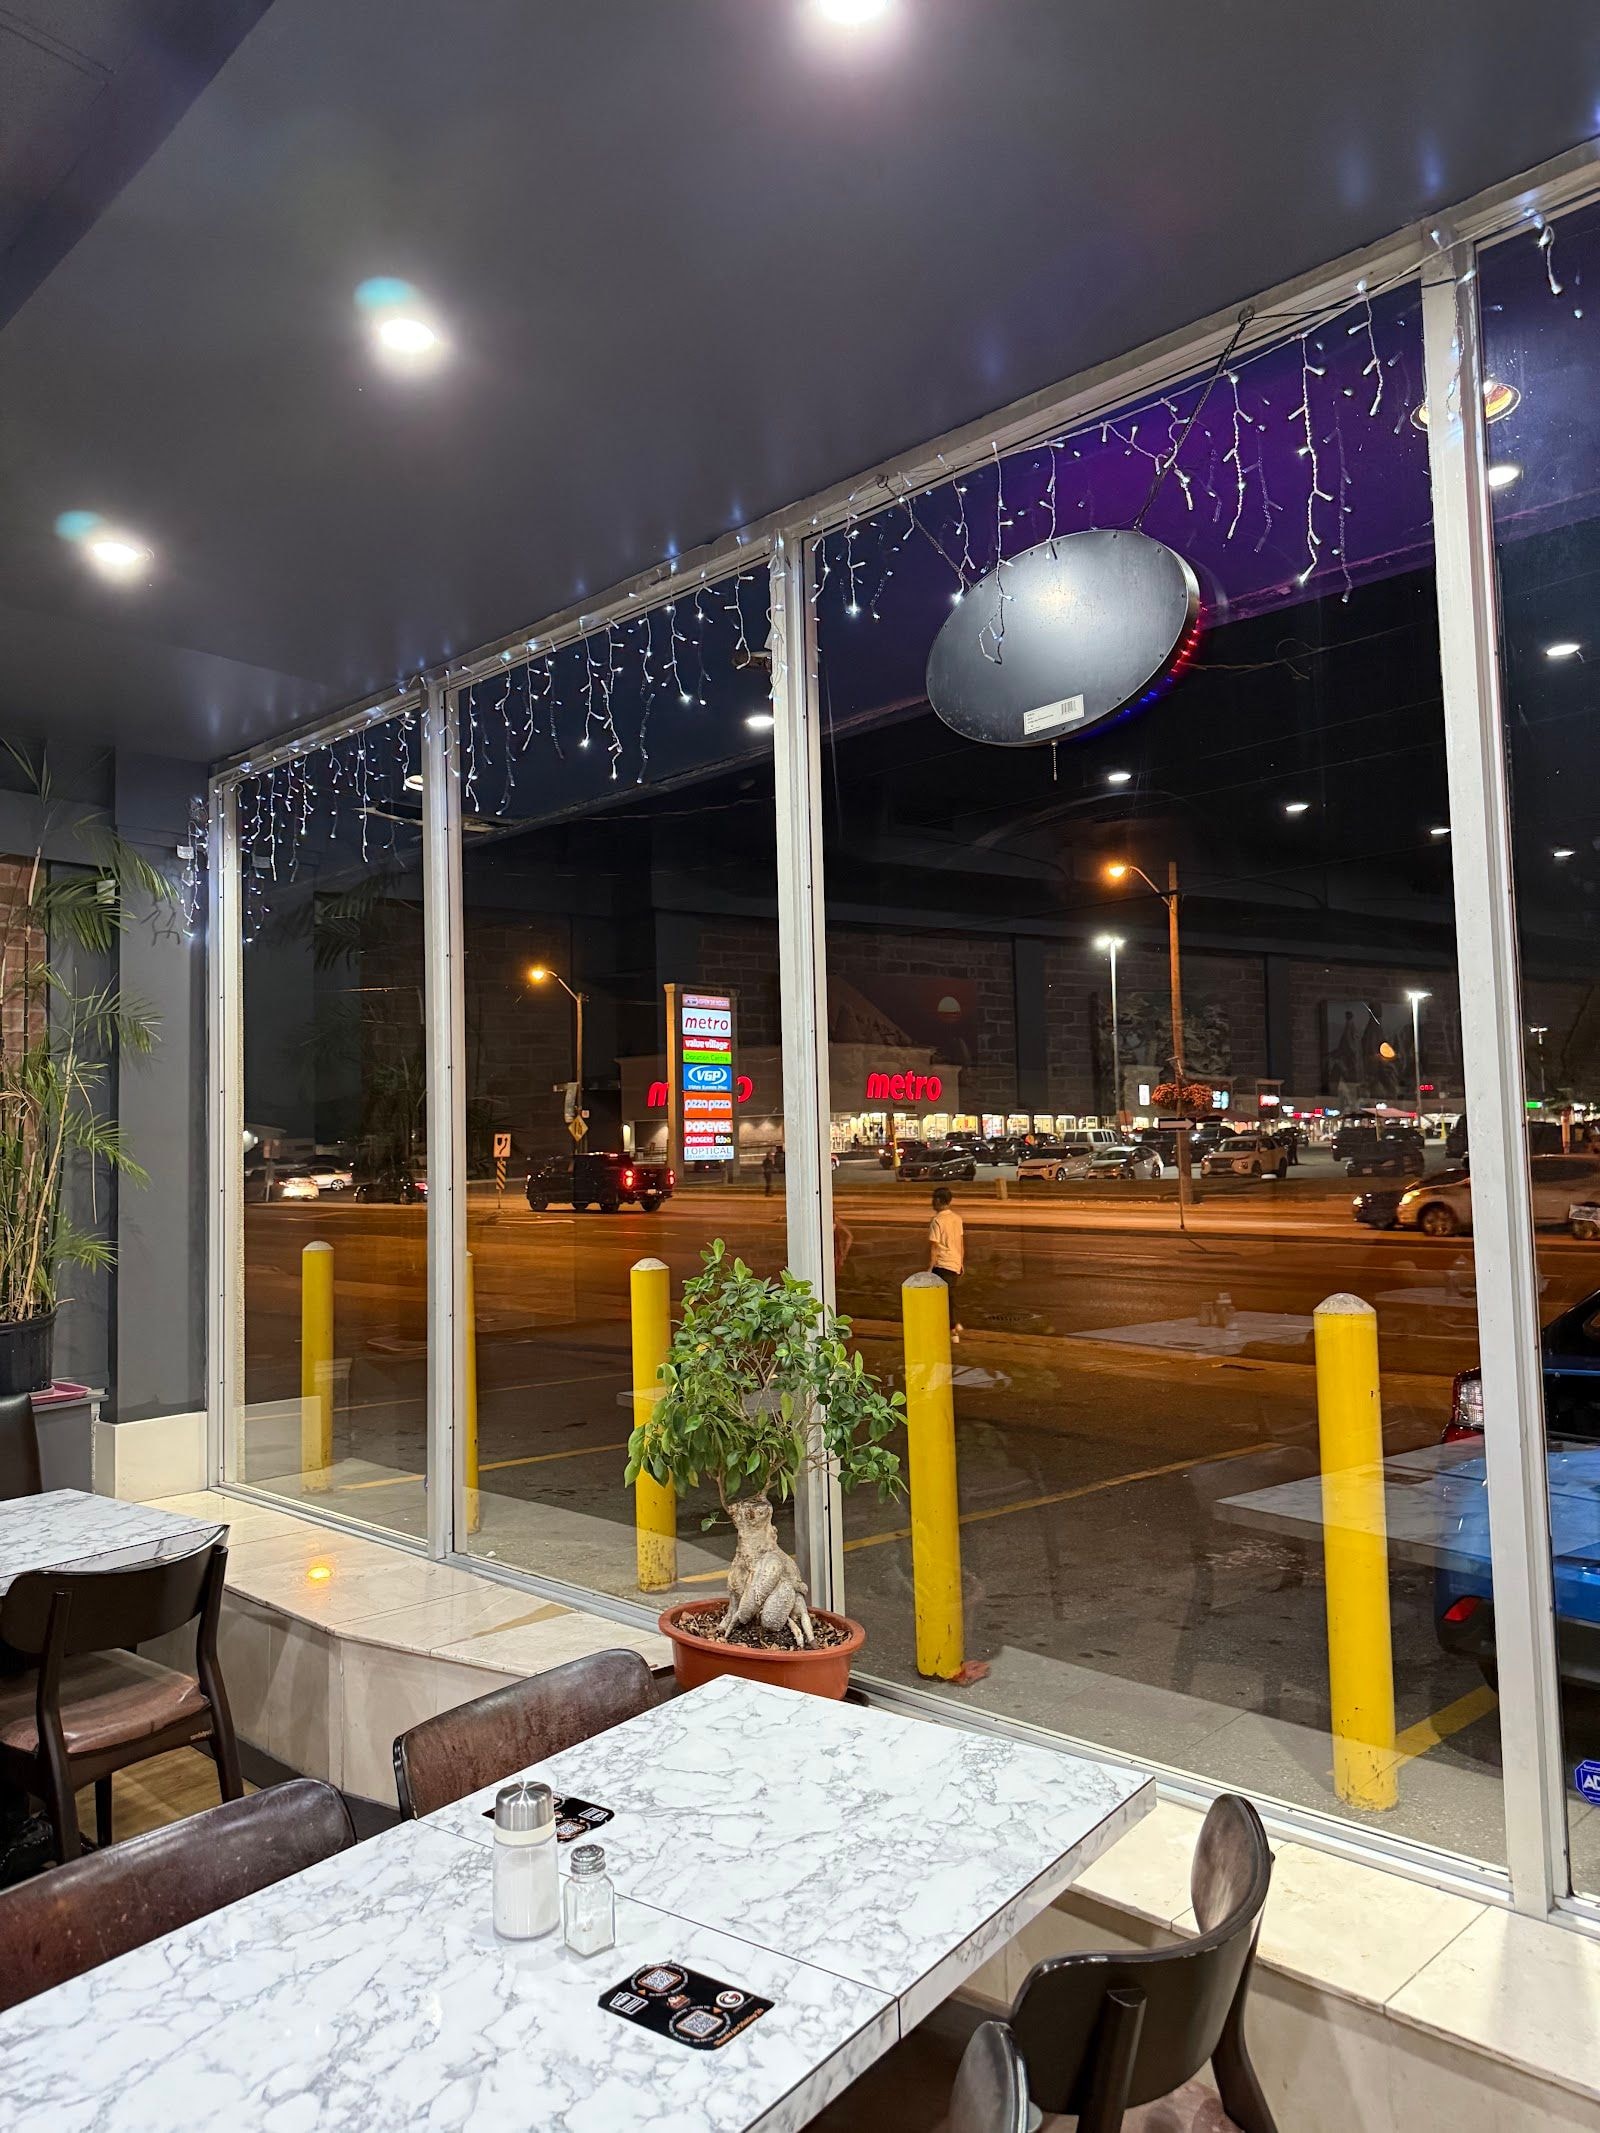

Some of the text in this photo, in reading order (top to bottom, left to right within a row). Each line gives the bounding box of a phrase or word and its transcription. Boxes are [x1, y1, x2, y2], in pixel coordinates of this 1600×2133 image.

[685, 1017, 729, 1030] metro
[696, 1070, 721, 1081] VGP
[866, 1070, 942, 1101] metro
[685, 1099, 731, 1111] pizza pizza
[691, 1147, 732, 1155] OPTICAL
[1583, 1774, 1600, 1791] AD
